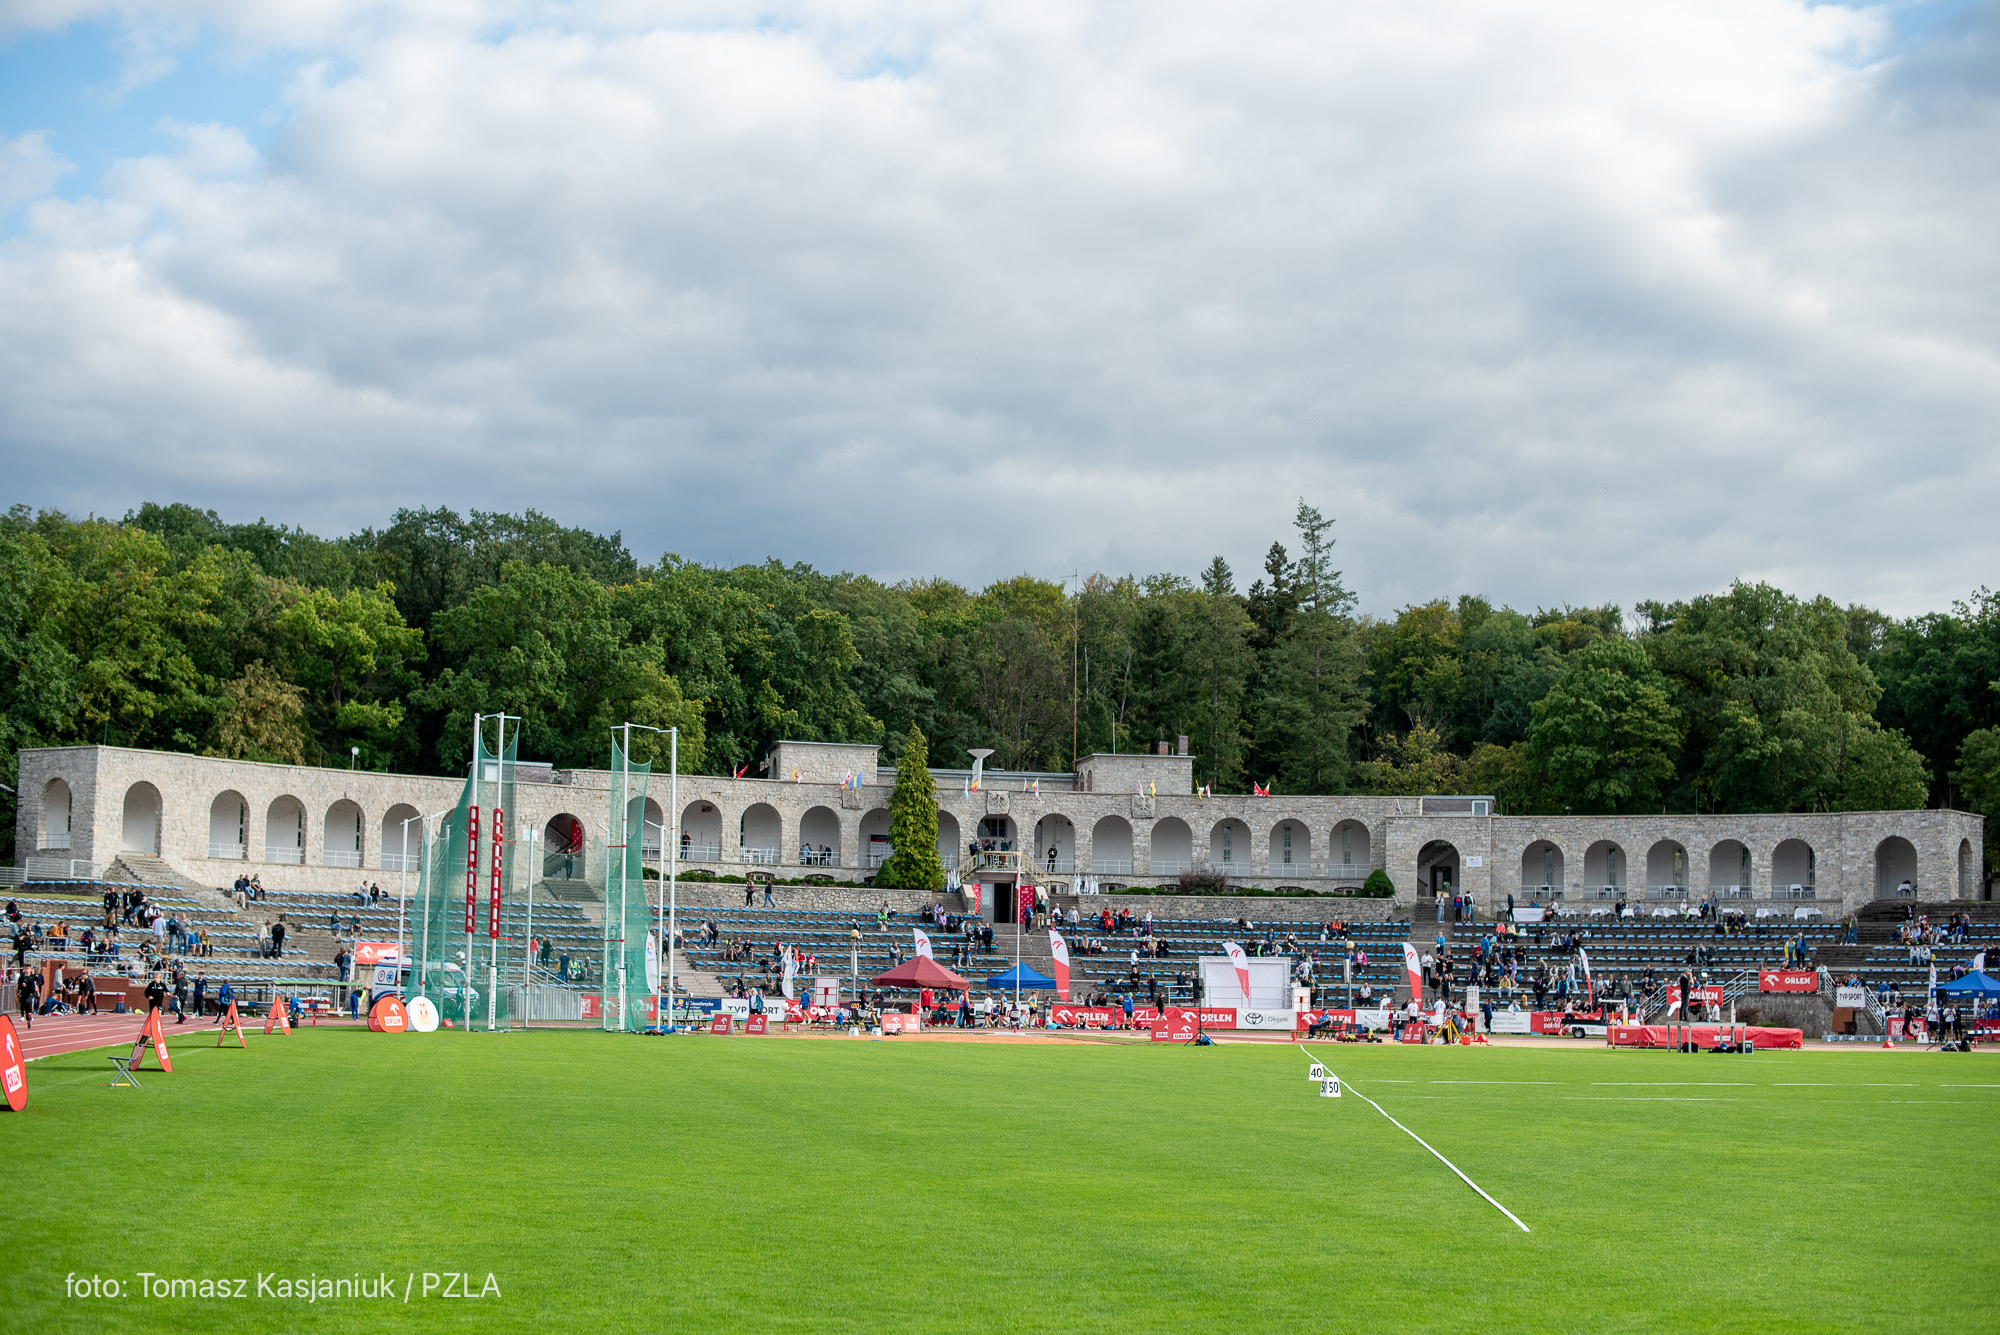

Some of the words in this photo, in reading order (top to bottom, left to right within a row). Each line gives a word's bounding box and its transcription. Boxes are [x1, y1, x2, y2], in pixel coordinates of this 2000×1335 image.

[1075, 1012, 1109, 1021] ORLEN
[1200, 1014, 1232, 1022] ORLEN
[1311, 1068, 1322, 1077] 40
[1329, 1081, 1339, 1093] 50
